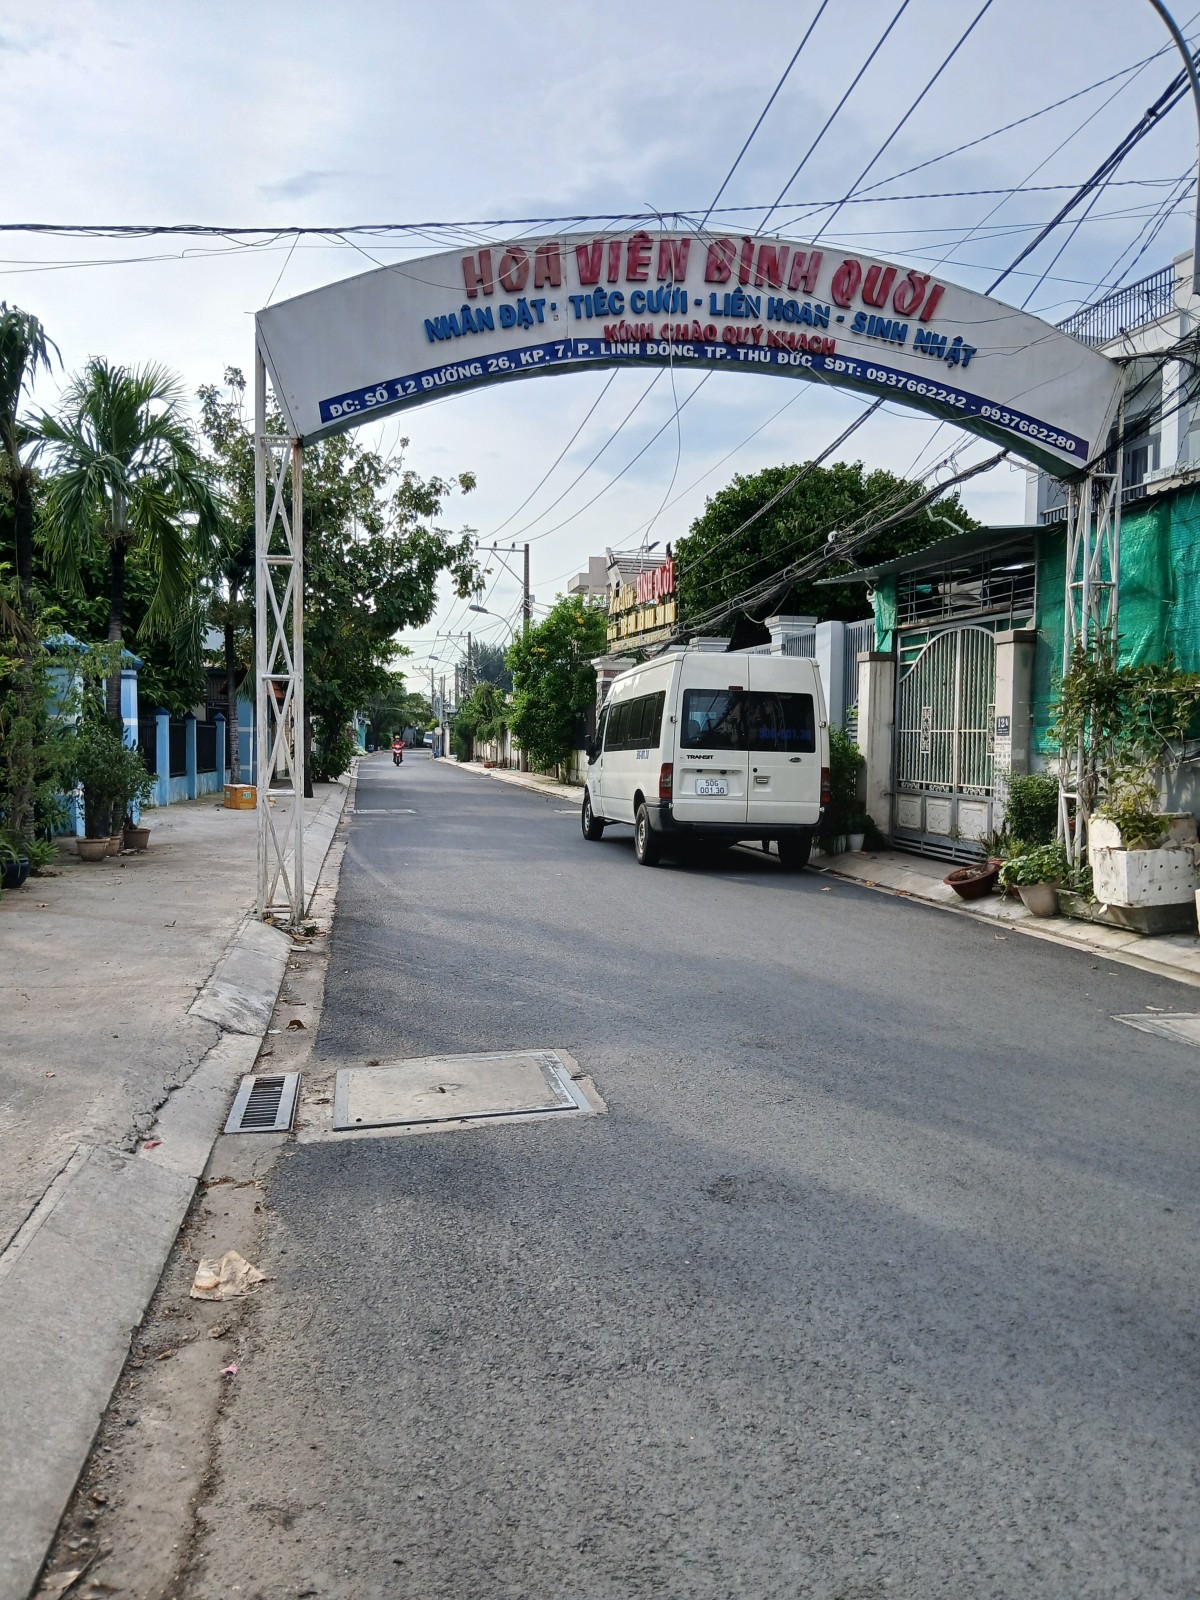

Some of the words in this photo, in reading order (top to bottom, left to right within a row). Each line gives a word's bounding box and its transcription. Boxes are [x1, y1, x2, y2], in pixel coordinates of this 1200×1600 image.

[462, 242, 561, 298] HOA
[576, 230, 691, 285] VIÊN
[705, 236, 823, 294] BÌNH
[603, 319, 654, 343] KÍNH
[661, 320, 718, 343] CHÀO
[722, 324, 764, 346] QUÝ
[630, 282, 688, 315] CƯỚI
[709, 286, 761, 319] LIÊN
[767, 297, 830, 328] HOAN
[850, 311, 908, 346] SINH
[913, 328, 977, 369] NHẬT
[329, 399, 361, 418] ĐC:
[364, 383, 389, 406] SỐ
[397, 380, 418, 397] 12
[421, 363, 483, 388] ĐƯỜNG
[488, 357, 516, 373] 26,
[520, 350, 550, 365] KP.
[554, 345, 572, 359] 7,
[577, 343, 594, 355] P.
[600, 343, 640, 355] LINH
[646, 342, 699, 358] ĐÔNG.
[704, 347, 731, 360] TP.
[737, 347, 771, 363] THỦ
[777, 351, 812, 367] ĐỨC
[823, 358, 861, 376] SĐT:
[866, 368, 967, 409] 0937662242
[980, 404, 1076, 452] 0937662280
[700, 786, 725, 794] 001.30
[705, 779, 719, 787] 50G
